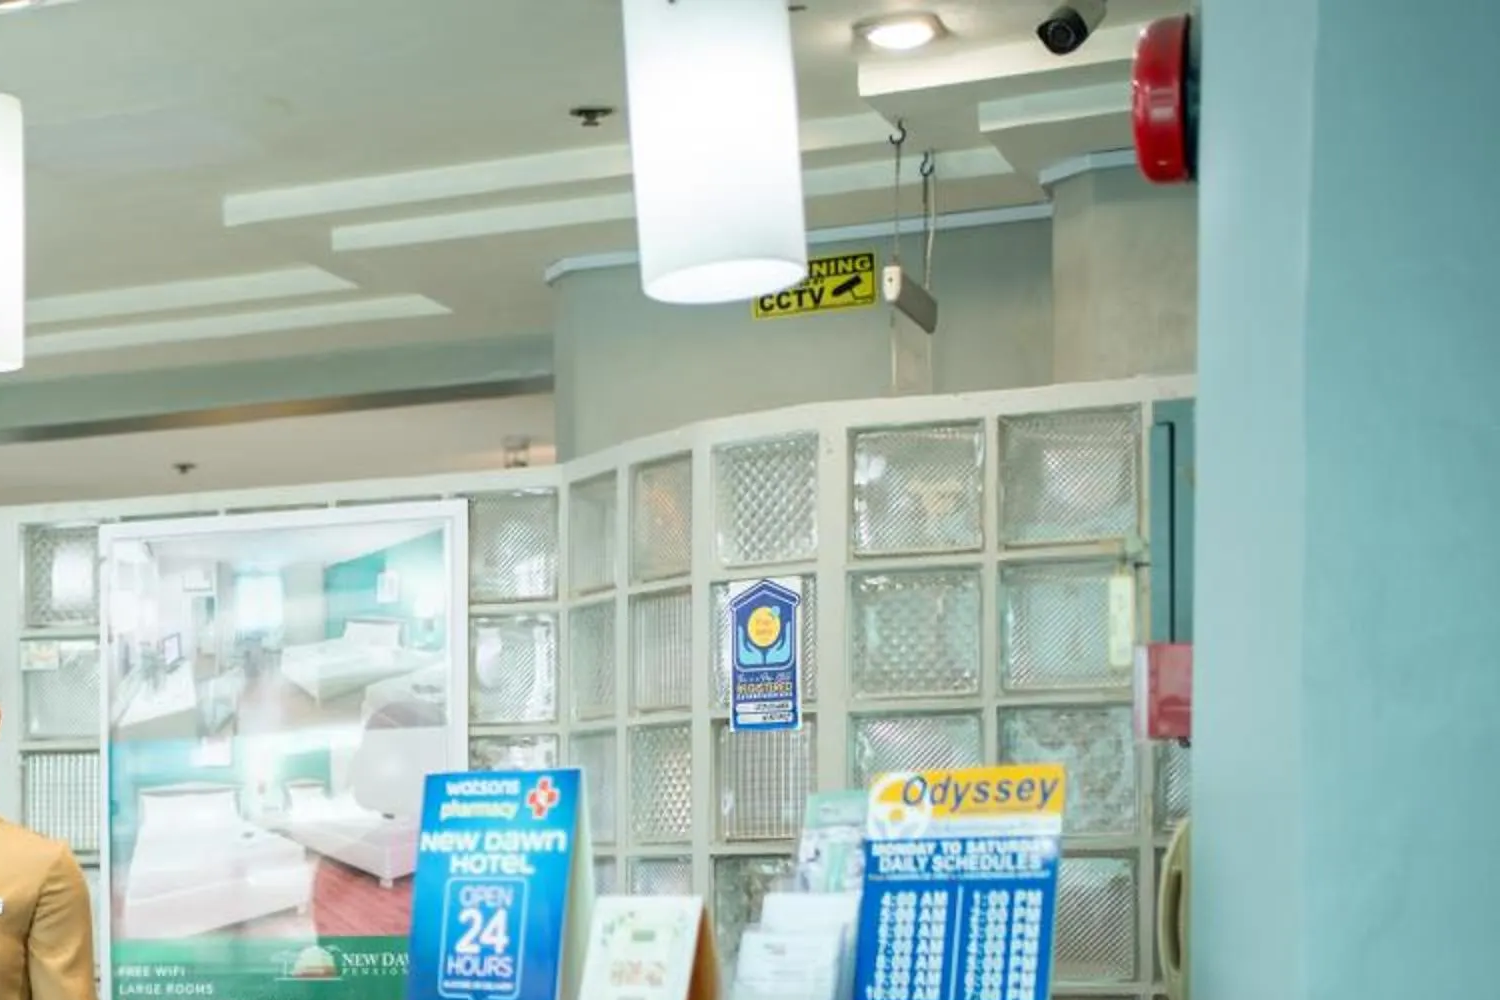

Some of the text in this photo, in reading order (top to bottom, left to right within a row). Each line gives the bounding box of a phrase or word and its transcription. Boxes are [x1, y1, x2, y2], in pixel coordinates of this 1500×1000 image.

[812, 255, 871, 277] NING
[759, 286, 825, 312] CCTV
[902, 775, 1060, 813] Odyssey
[940, 840, 962, 855] TO
[965, 838, 1053, 856] SATUR
[879, 854, 929, 873] DAILY
[459, 885, 514, 908] OPEN
[920, 891, 948, 907] AM
[1014, 890, 1042, 906] PM
[918, 907, 947, 922] AM
[1013, 906, 1041, 922] PM
[455, 907, 511, 954] 24
[918, 923, 945, 938] AM
[1012, 923, 1040, 938] PM
[916, 939, 944, 954] AM
[1011, 939, 1038, 954] PM
[342, 952, 409, 967] NEW DA
[447, 954, 514, 978] HOURS
[914, 954, 942, 970] AM
[1010, 955, 1037, 971] PM
[118, 965, 150, 977] FREE
[914, 970, 941, 986] AM
[1008, 971, 1036, 987] PM
[118, 983, 214, 995] LARGE ROOMS
